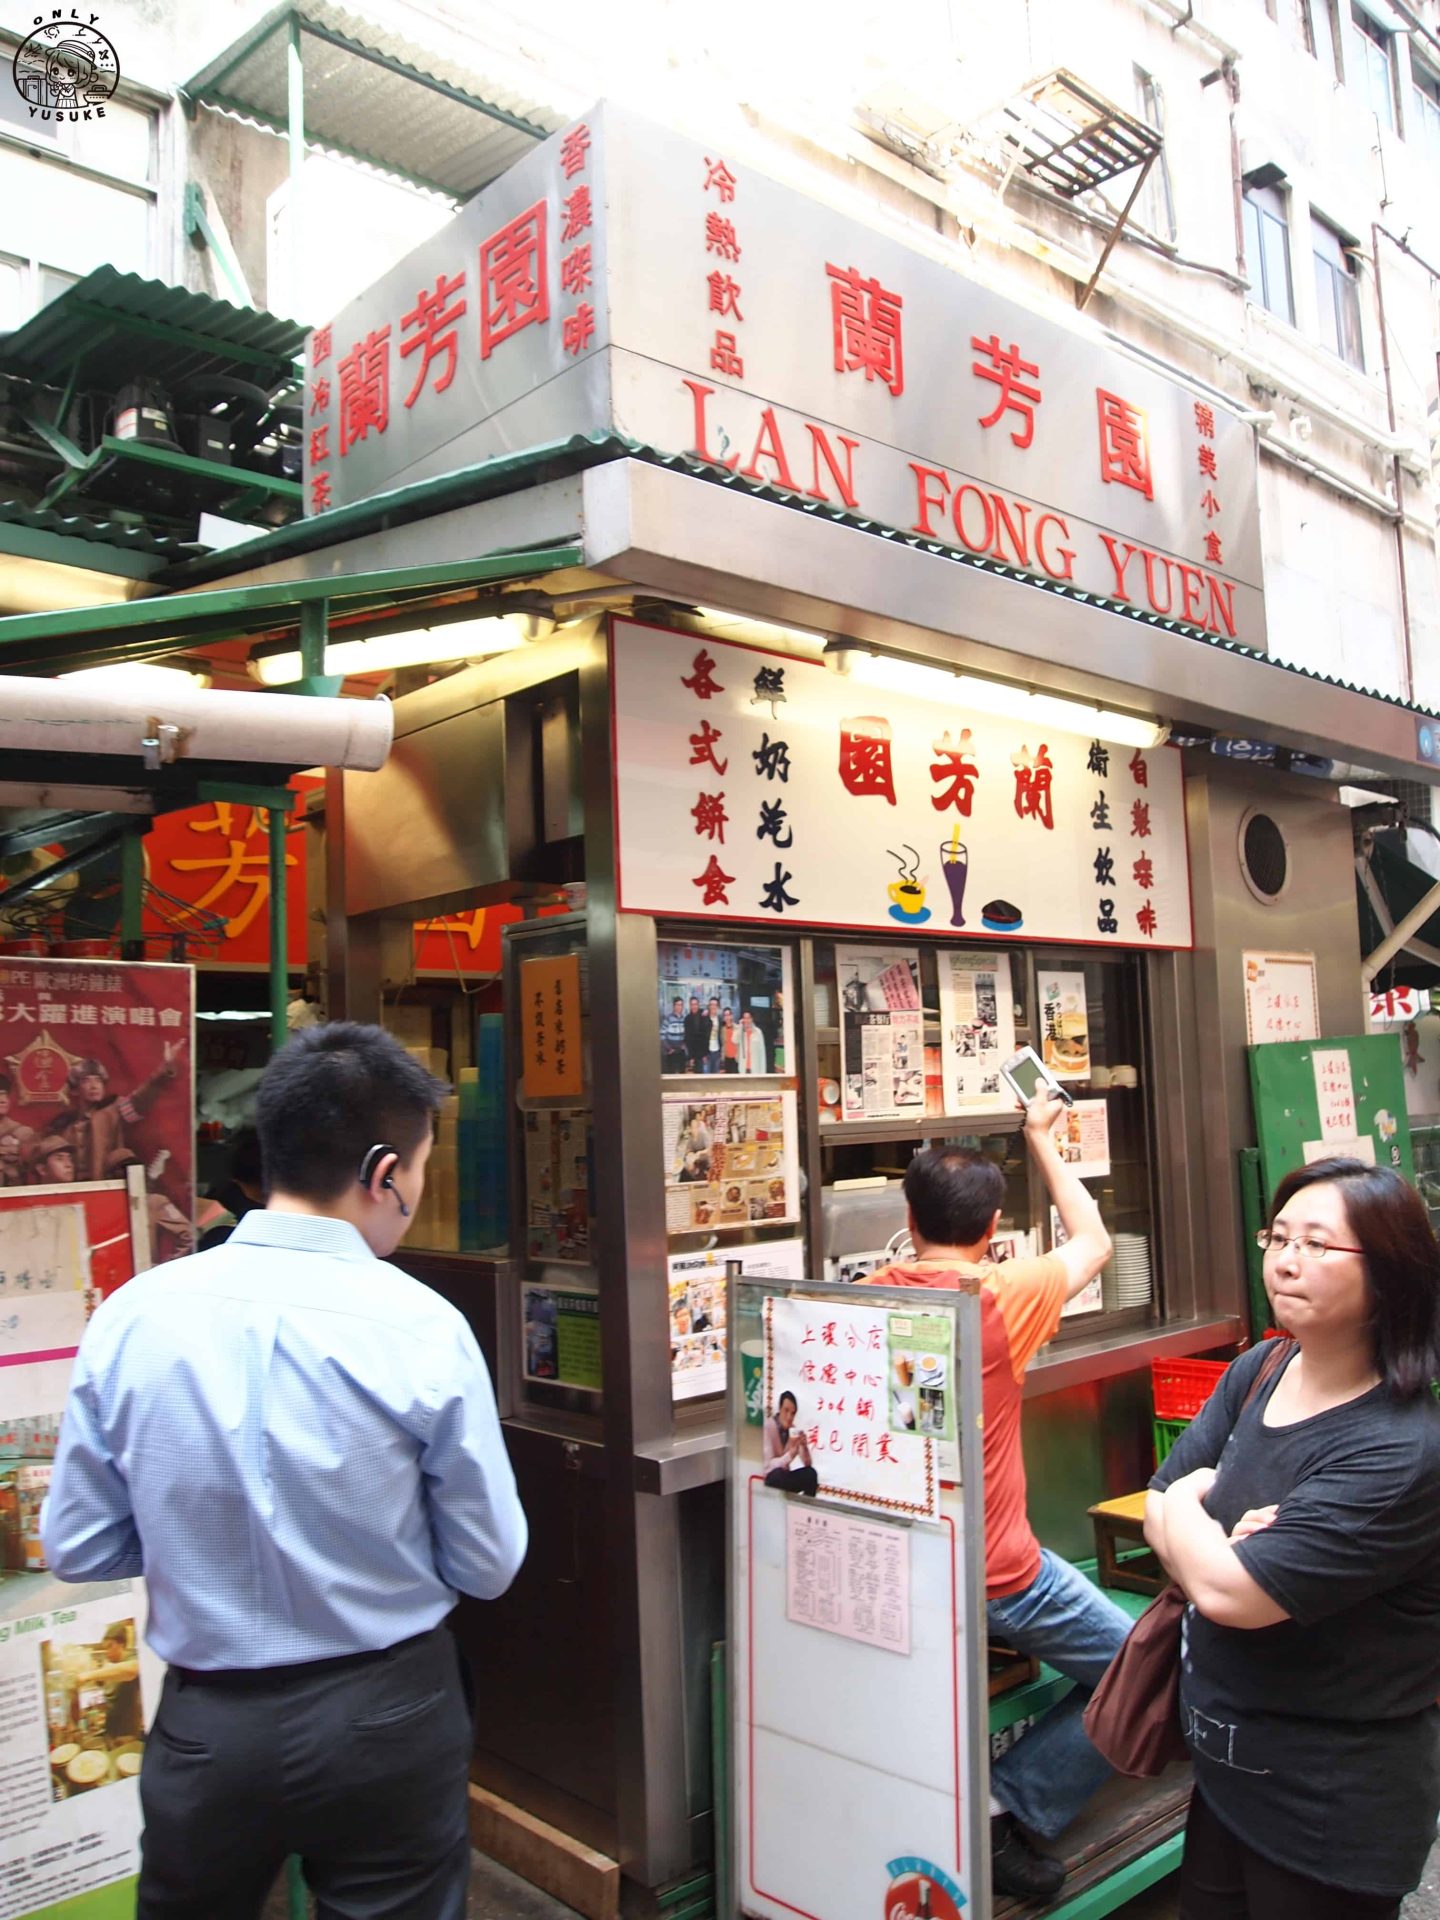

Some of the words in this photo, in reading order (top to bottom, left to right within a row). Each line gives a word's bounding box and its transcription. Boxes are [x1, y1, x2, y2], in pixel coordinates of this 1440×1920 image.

[338, 198, 550, 458] 蘭芳園
[702, 155, 744, 380] 冷熱飲品
[310, 322, 333, 515] 西冷紅茶
[825, 260, 1156, 502] 蘭芳園
[1194, 400, 1224, 566] 精美小食
[682, 378, 861, 508] LAN
[908, 462, 1077, 581] FONG
[1099, 532, 1237, 637] YUEN
[680, 649, 736, 907] 各式餅食
[1086, 738, 1119, 936] 衛生飲品
[0, 1001, 184, 1027] 大躍進演唱會
[15, 1616, 46, 1635] Milk
[51, 1610, 77, 1626] Tea
